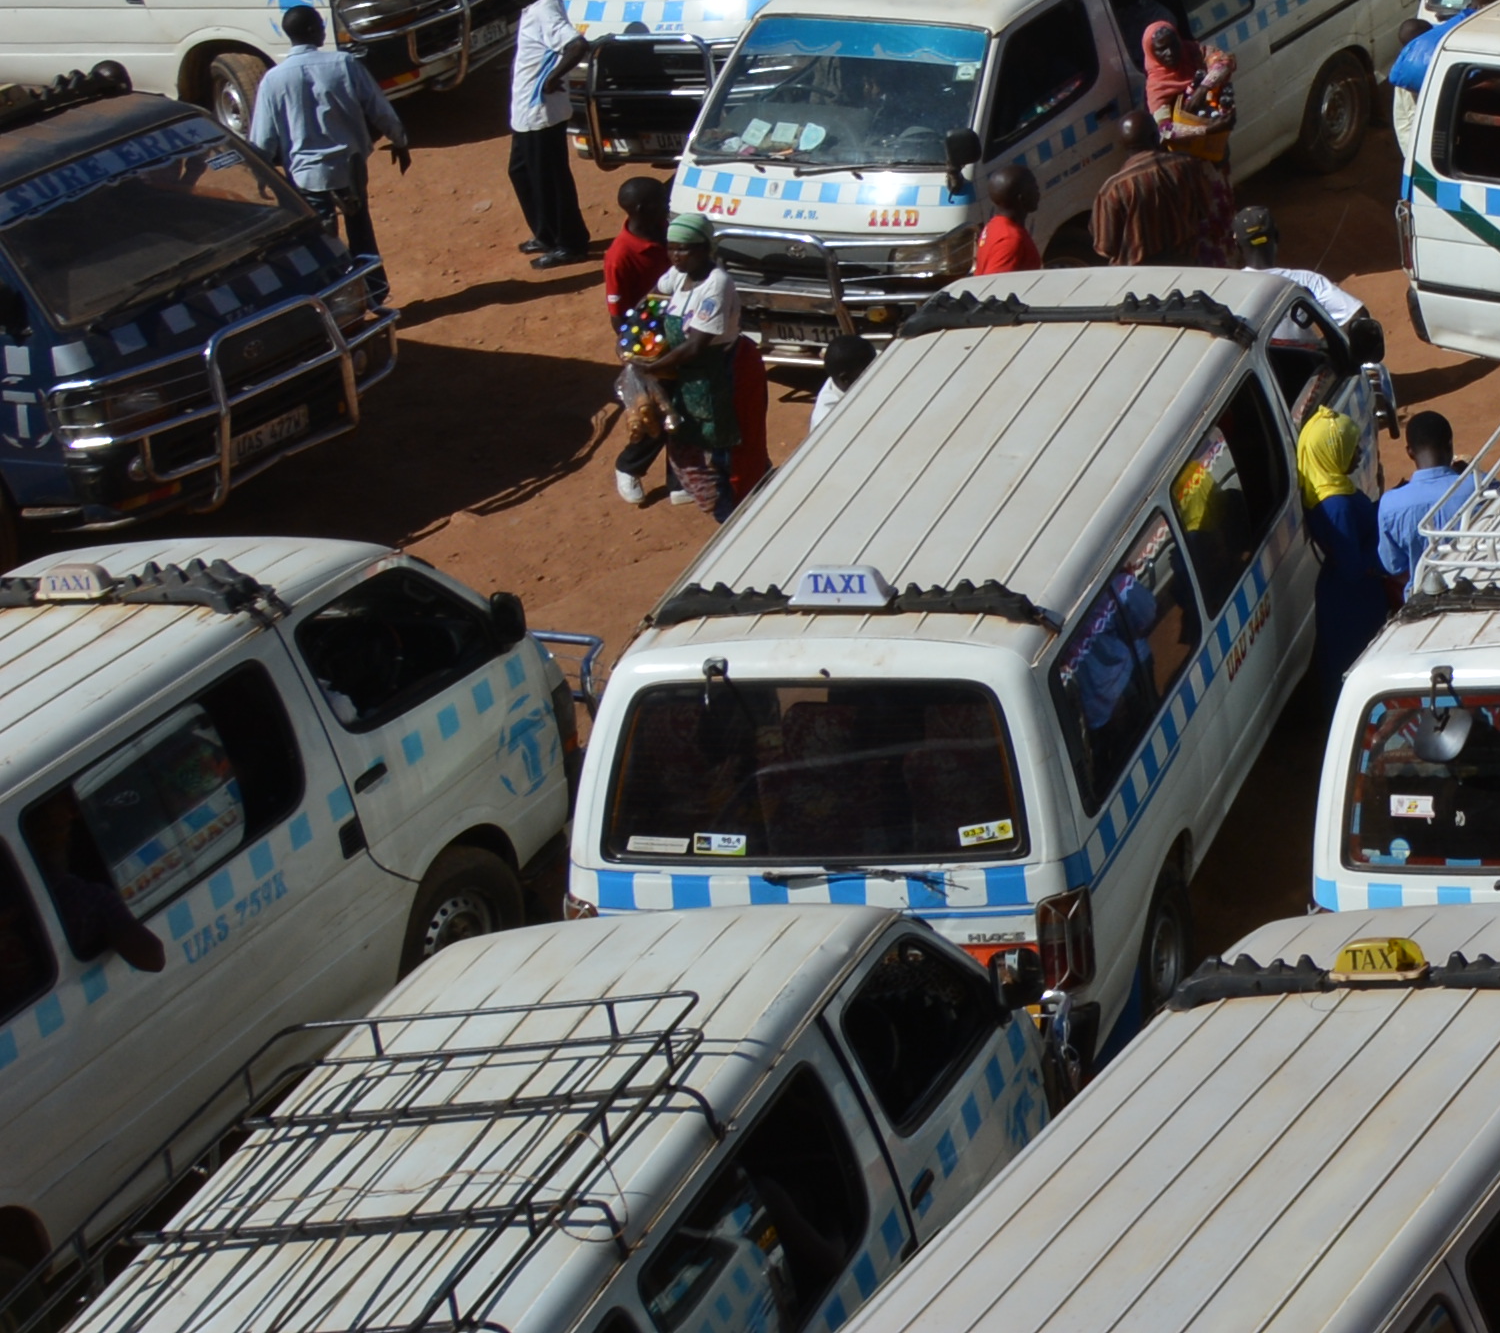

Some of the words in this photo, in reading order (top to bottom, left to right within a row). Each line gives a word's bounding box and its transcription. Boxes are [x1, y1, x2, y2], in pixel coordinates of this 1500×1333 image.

[4, 152, 106, 214] SURE
[114, 124, 189, 169] ERA
[695, 193, 741, 217] UAJ
[868, 208, 919, 229] 111D
[808, 573, 868, 595] TAXI
